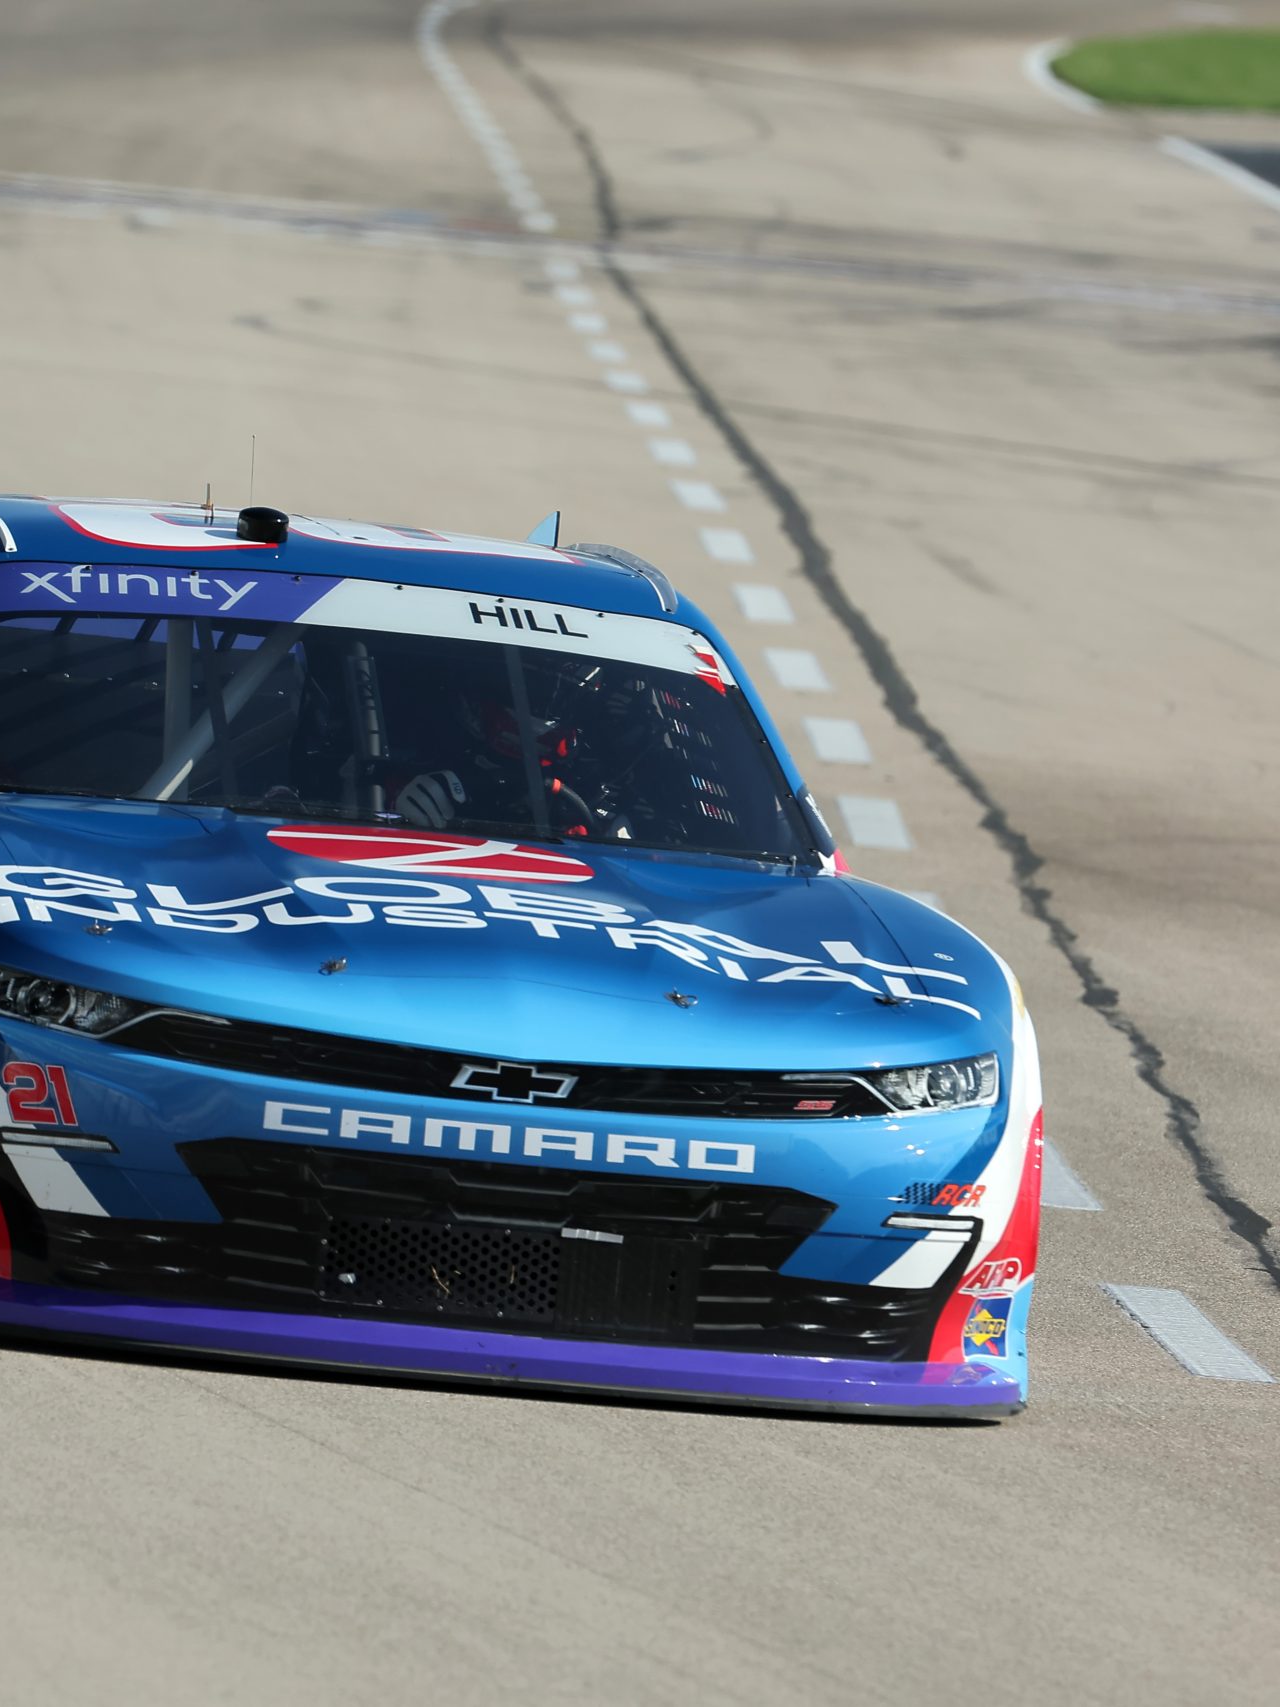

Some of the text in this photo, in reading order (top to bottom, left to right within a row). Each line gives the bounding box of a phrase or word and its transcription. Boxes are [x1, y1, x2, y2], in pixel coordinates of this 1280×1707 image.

[20, 565, 257, 611] xfinity
[468, 601, 590, 639] HILL
[2, 1061, 79, 1127] 21
[262, 1100, 757, 1174] CAMARO
[931, 1184, 988, 1207] RCR
